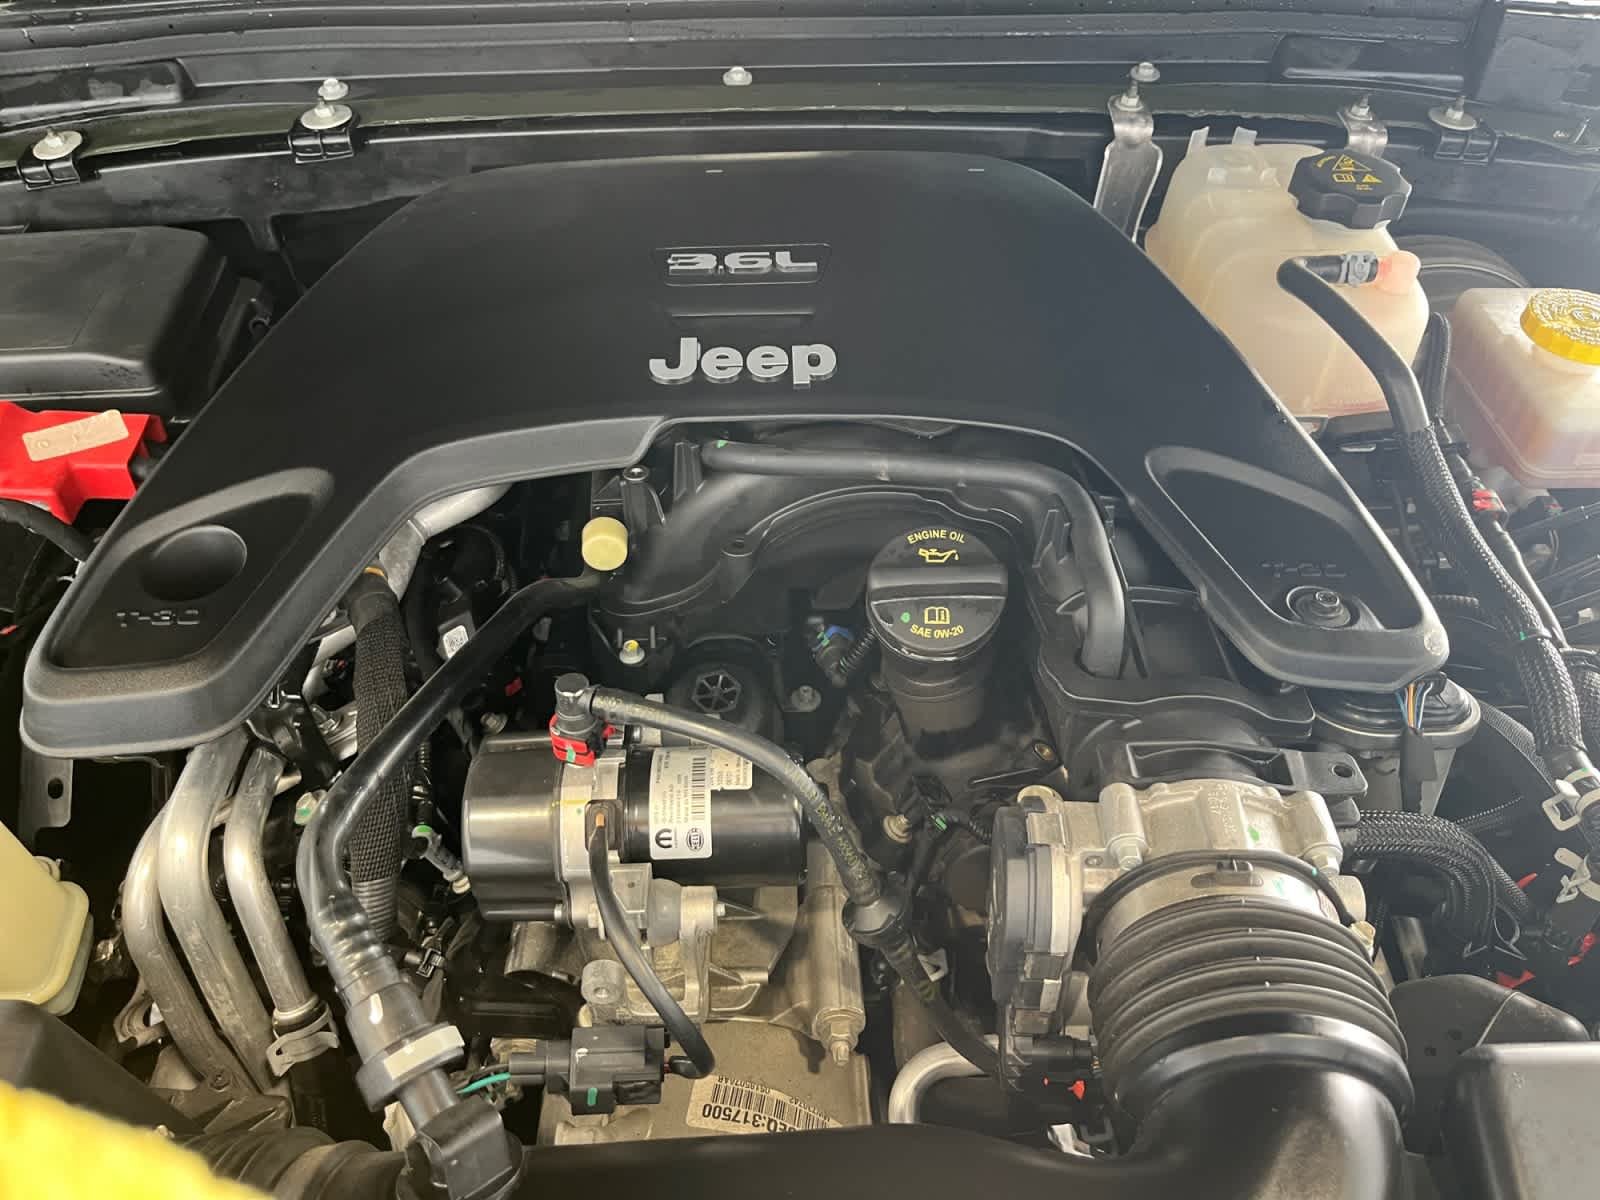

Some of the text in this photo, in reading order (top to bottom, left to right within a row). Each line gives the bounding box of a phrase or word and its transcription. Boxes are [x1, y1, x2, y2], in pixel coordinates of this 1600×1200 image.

[667, 250, 818, 275] 3.6L
[649, 337, 838, 389] Jeep
[907, 529, 965, 544] ENGINE OIL
[910, 624, 964, 639] SAE 0W-20
